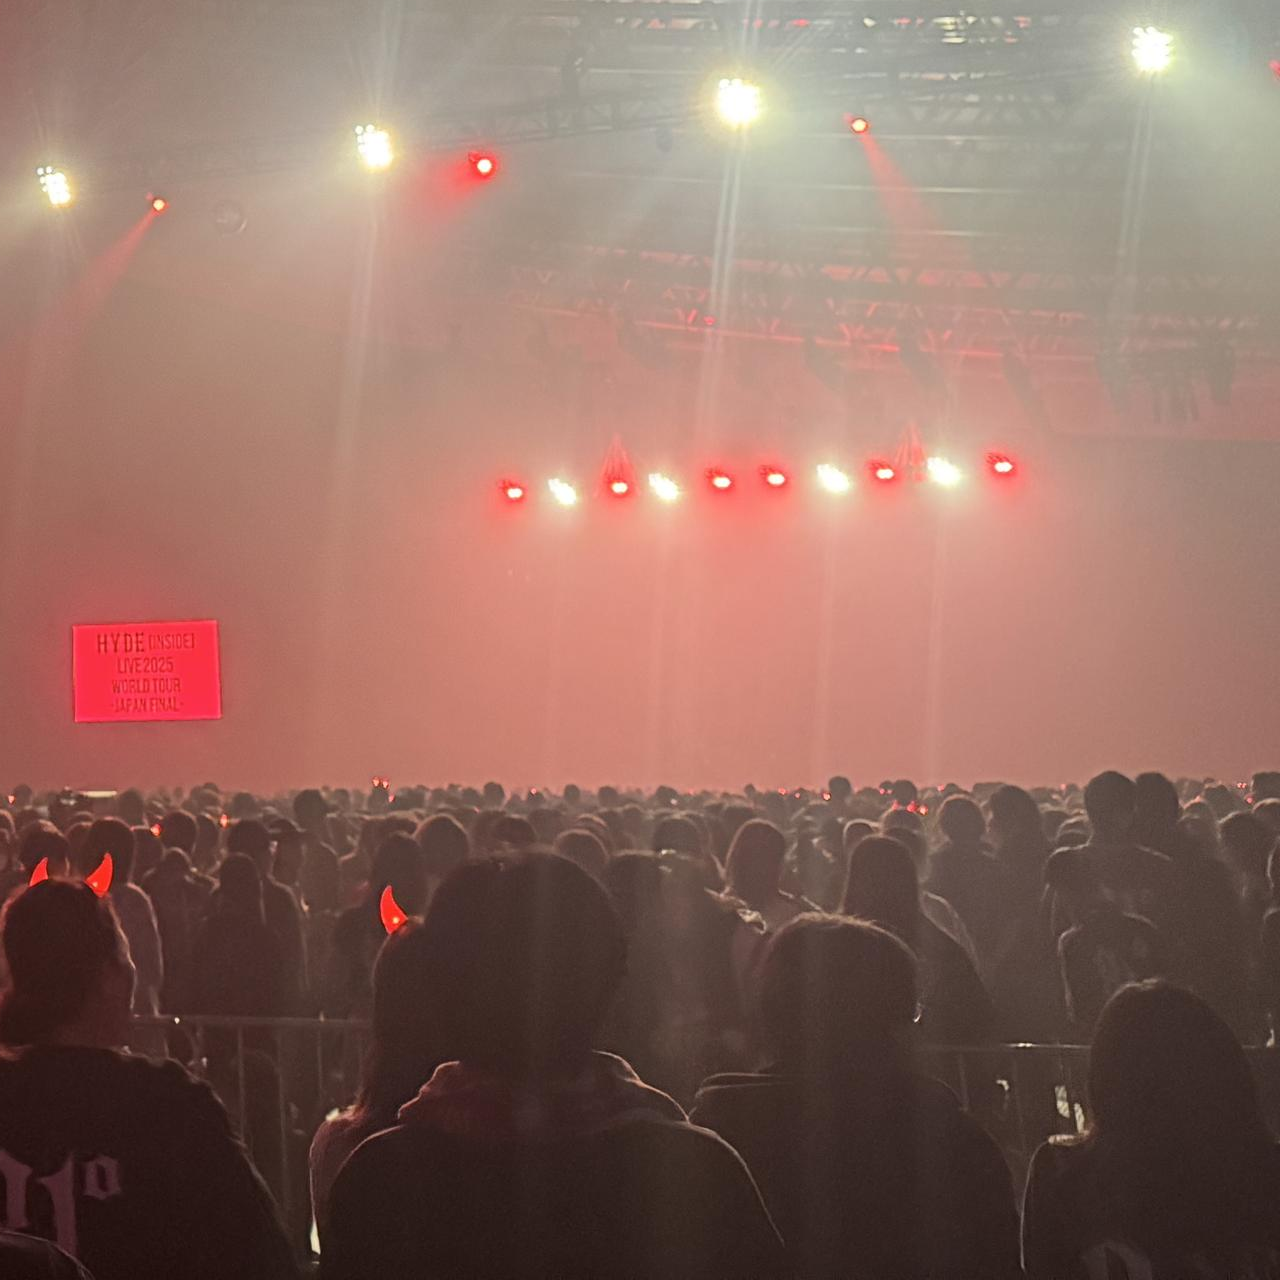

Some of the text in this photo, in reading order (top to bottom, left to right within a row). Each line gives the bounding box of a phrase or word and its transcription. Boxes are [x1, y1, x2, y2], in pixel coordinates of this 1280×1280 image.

[97, 632, 145, 654] HYDE
[112, 678, 181, 694] WORLD TOUR
